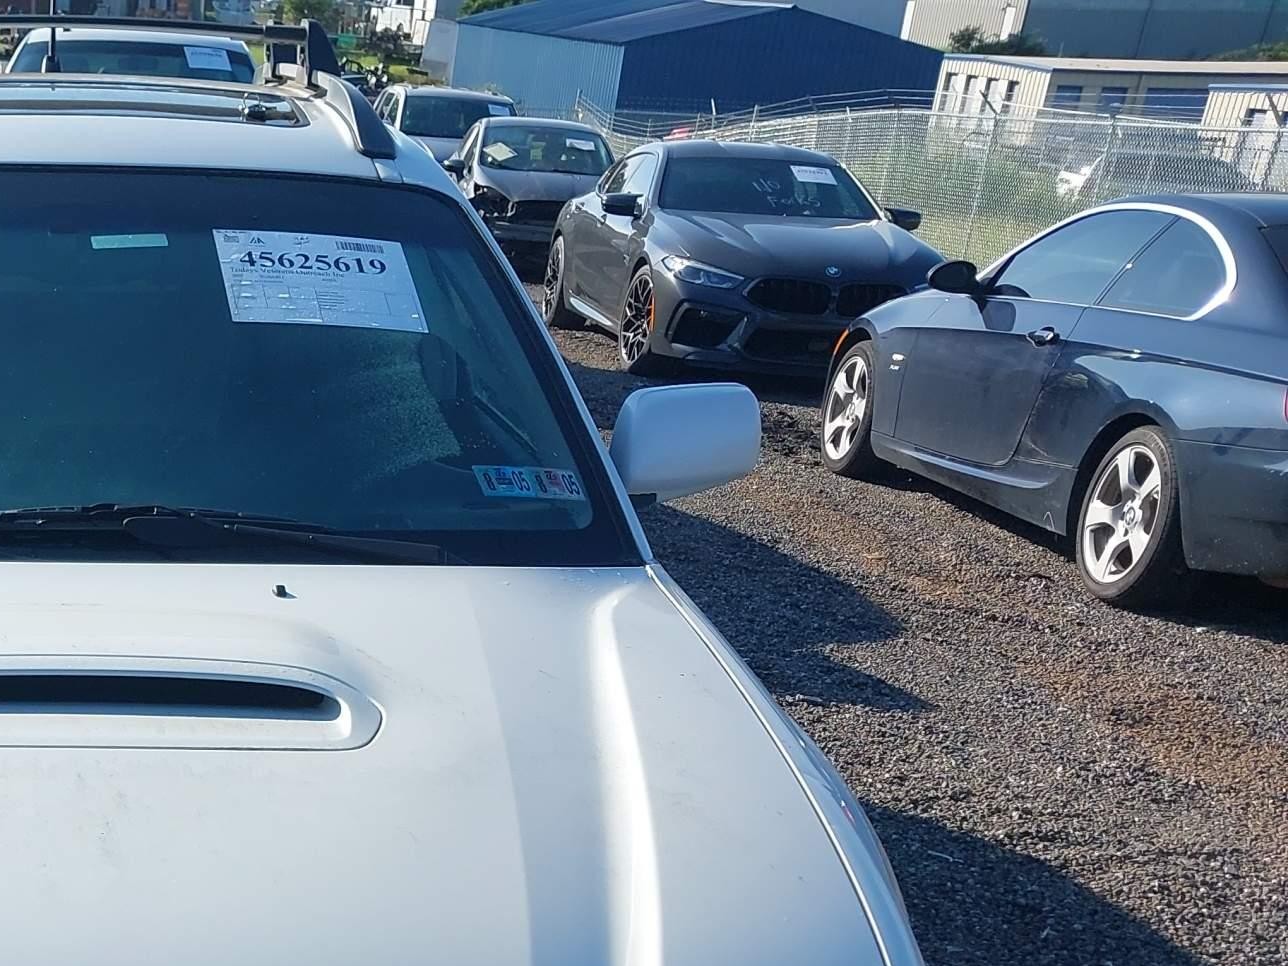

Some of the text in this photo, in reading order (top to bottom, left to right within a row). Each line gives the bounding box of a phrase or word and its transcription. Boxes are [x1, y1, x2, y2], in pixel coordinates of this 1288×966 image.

[240, 250, 387, 275] 45625619
[483, 472, 497, 491] 8
[511, 470, 532, 492] 05
[535, 474, 548, 494] 8
[560, 473, 581, 496] 05
